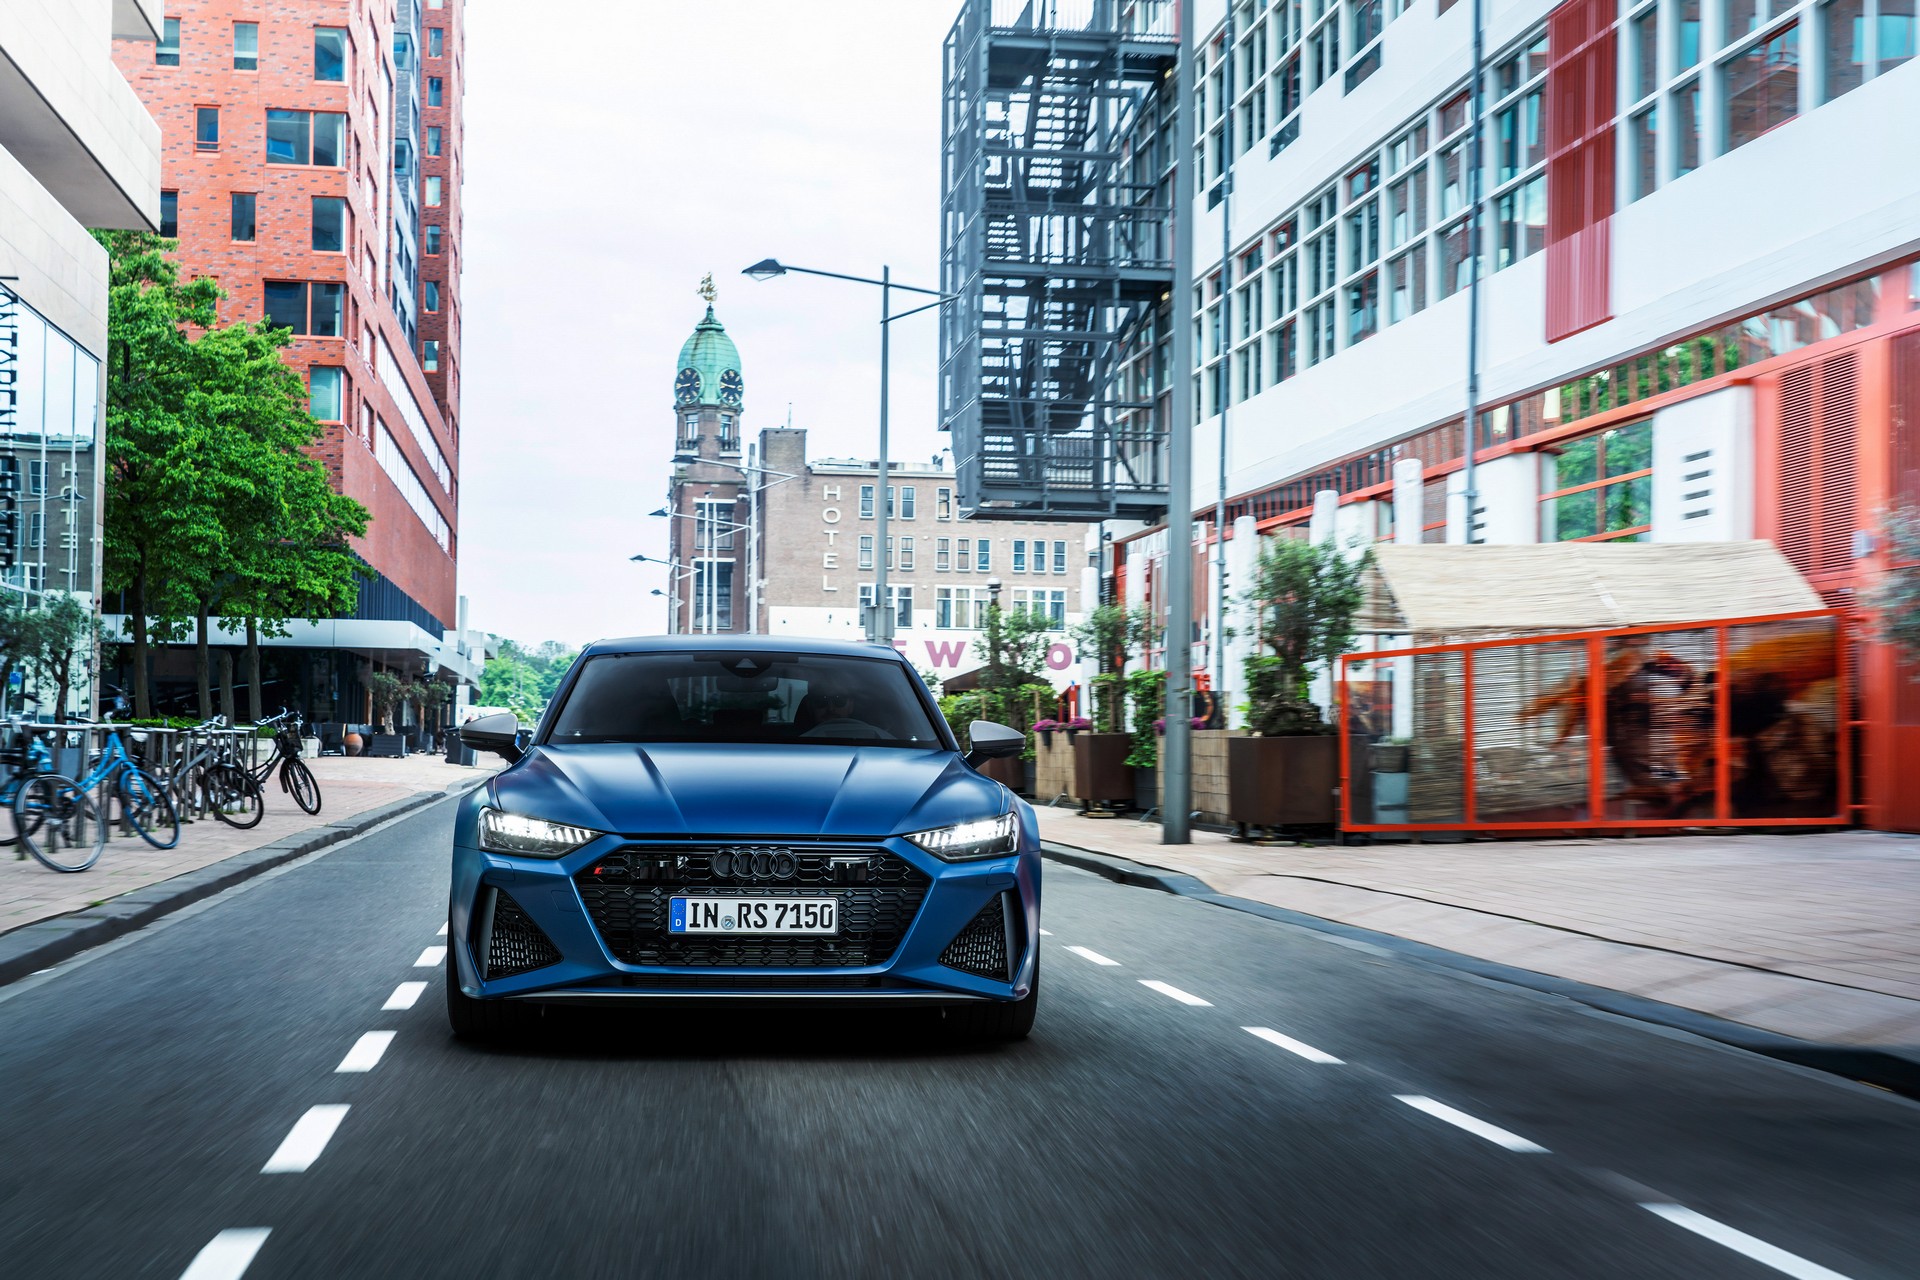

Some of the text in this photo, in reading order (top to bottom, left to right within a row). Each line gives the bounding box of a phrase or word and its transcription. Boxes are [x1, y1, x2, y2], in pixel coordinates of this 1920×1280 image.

[822, 485, 842, 591] HOTEL
[675, 918, 682, 927] D
[689, 902, 833, 929] IN RS 7150
